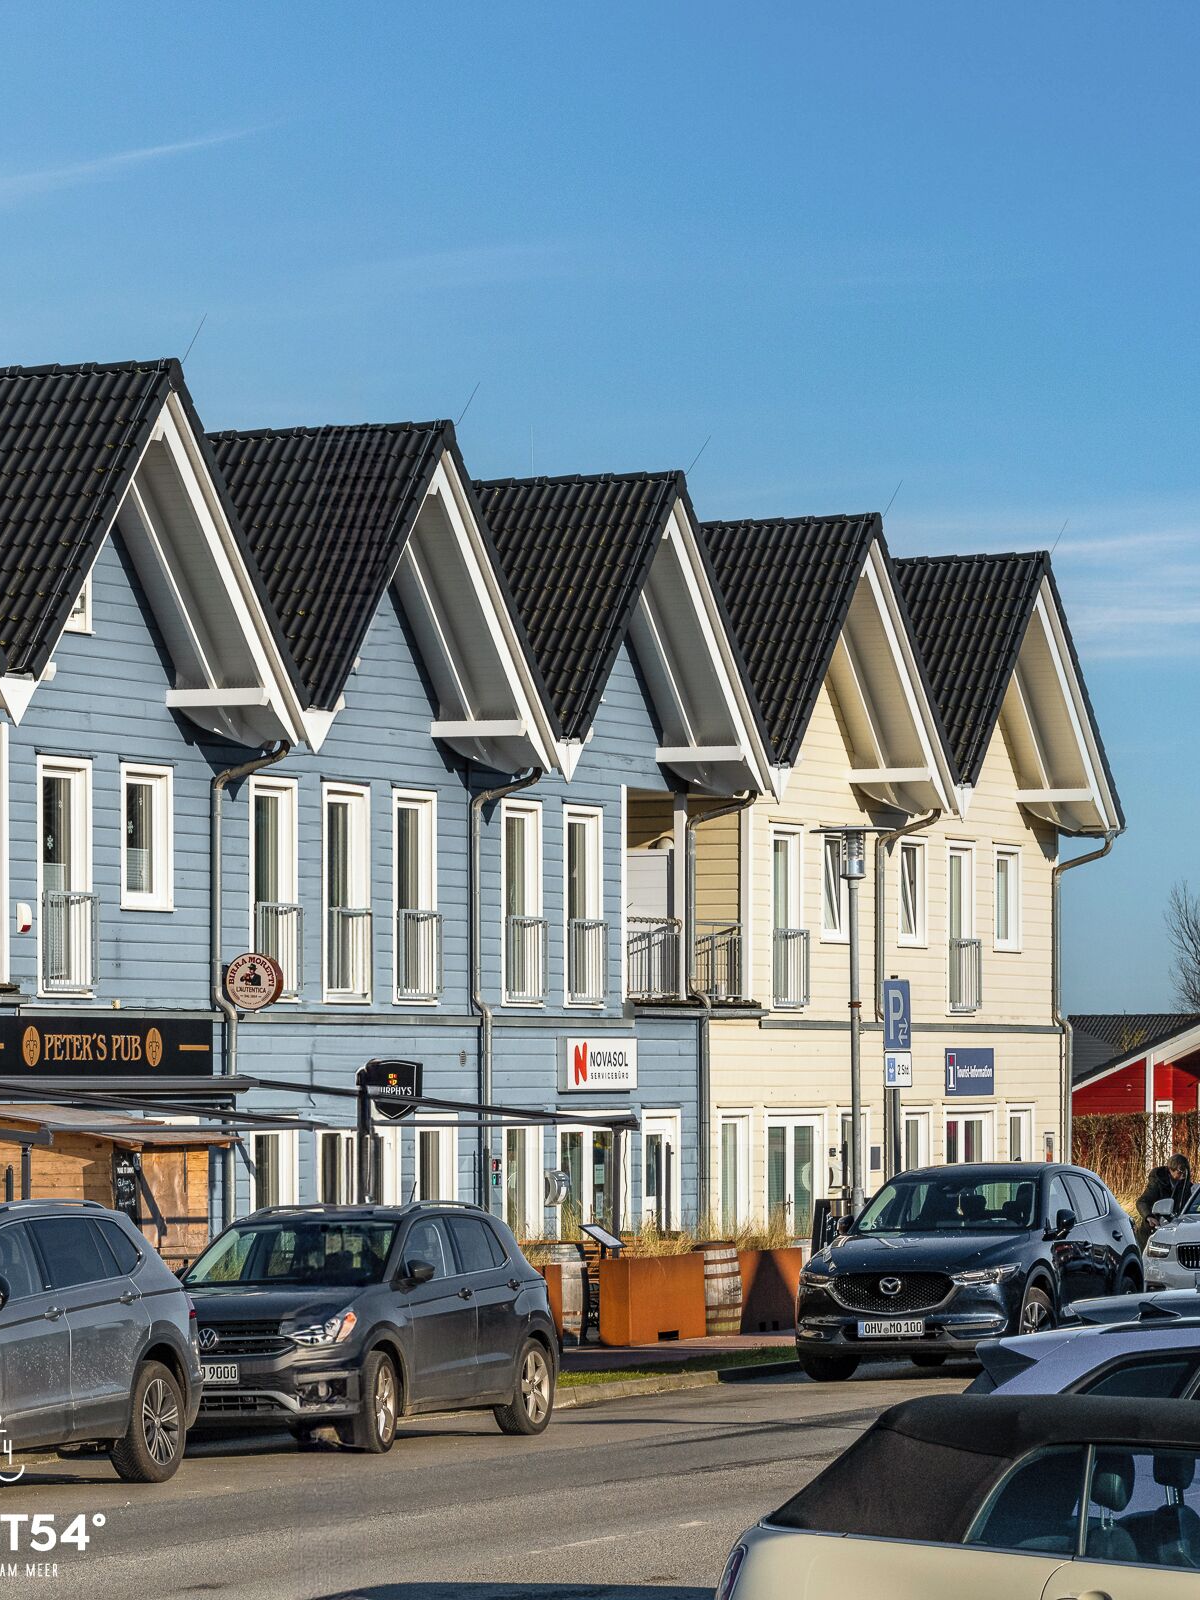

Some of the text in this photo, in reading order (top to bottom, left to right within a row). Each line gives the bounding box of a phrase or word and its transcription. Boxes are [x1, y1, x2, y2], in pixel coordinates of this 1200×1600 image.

[228, 956, 275, 987] BIRRA MORETTI
[888, 989, 904, 1040] P
[111, 1034, 142, 1062] PUB
[590, 1051, 629, 1067] NOVASOL
[590, 1070, 629, 1079] SERVICEBÜRO
[897, 1064, 901, 1076] 2
[865, 1322, 922, 1333] OHV MO 100
[209, 1366, 237, 1379] 9000
